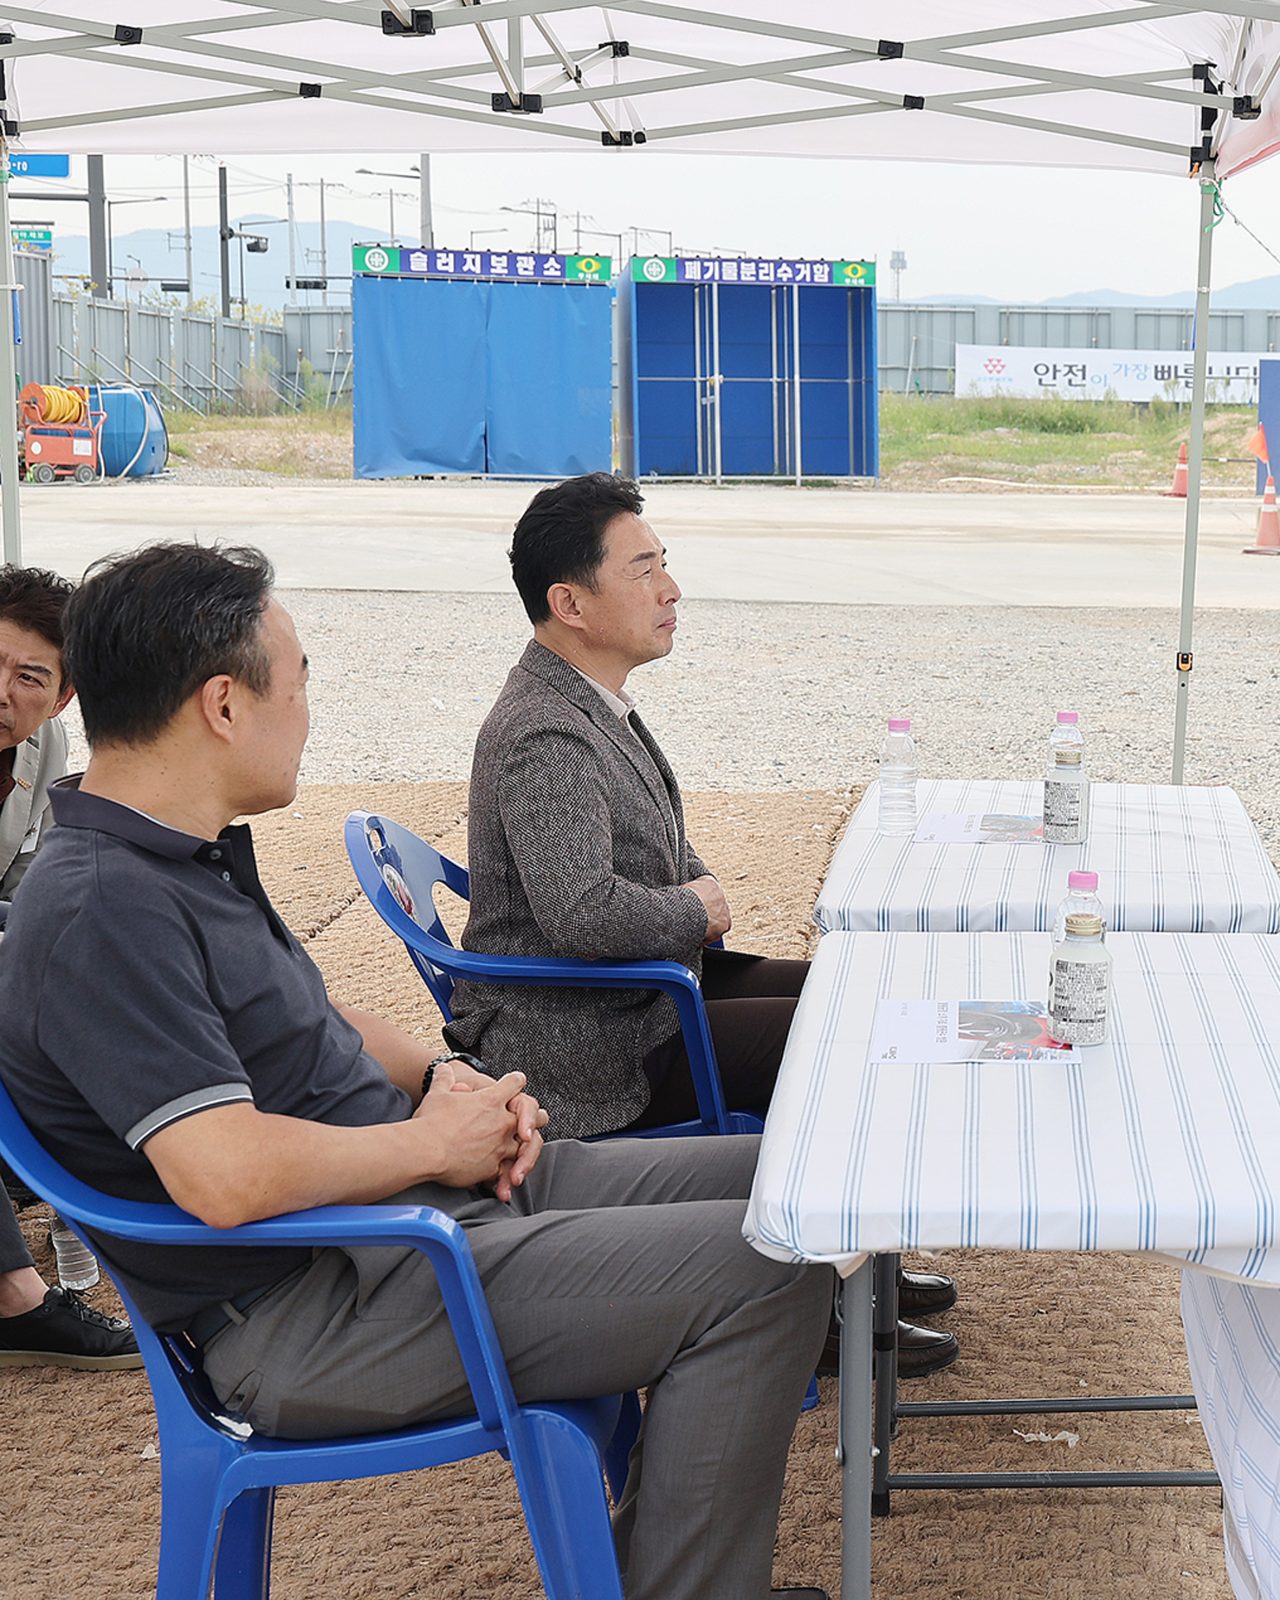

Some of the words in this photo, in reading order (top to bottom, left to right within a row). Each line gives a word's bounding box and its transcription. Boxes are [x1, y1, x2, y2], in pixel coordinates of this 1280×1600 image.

[409, 251, 562, 277] 슬러지보관소
[684, 260, 830, 283] 폐기물분리수거함
[1113, 362, 1150, 382] 가장
